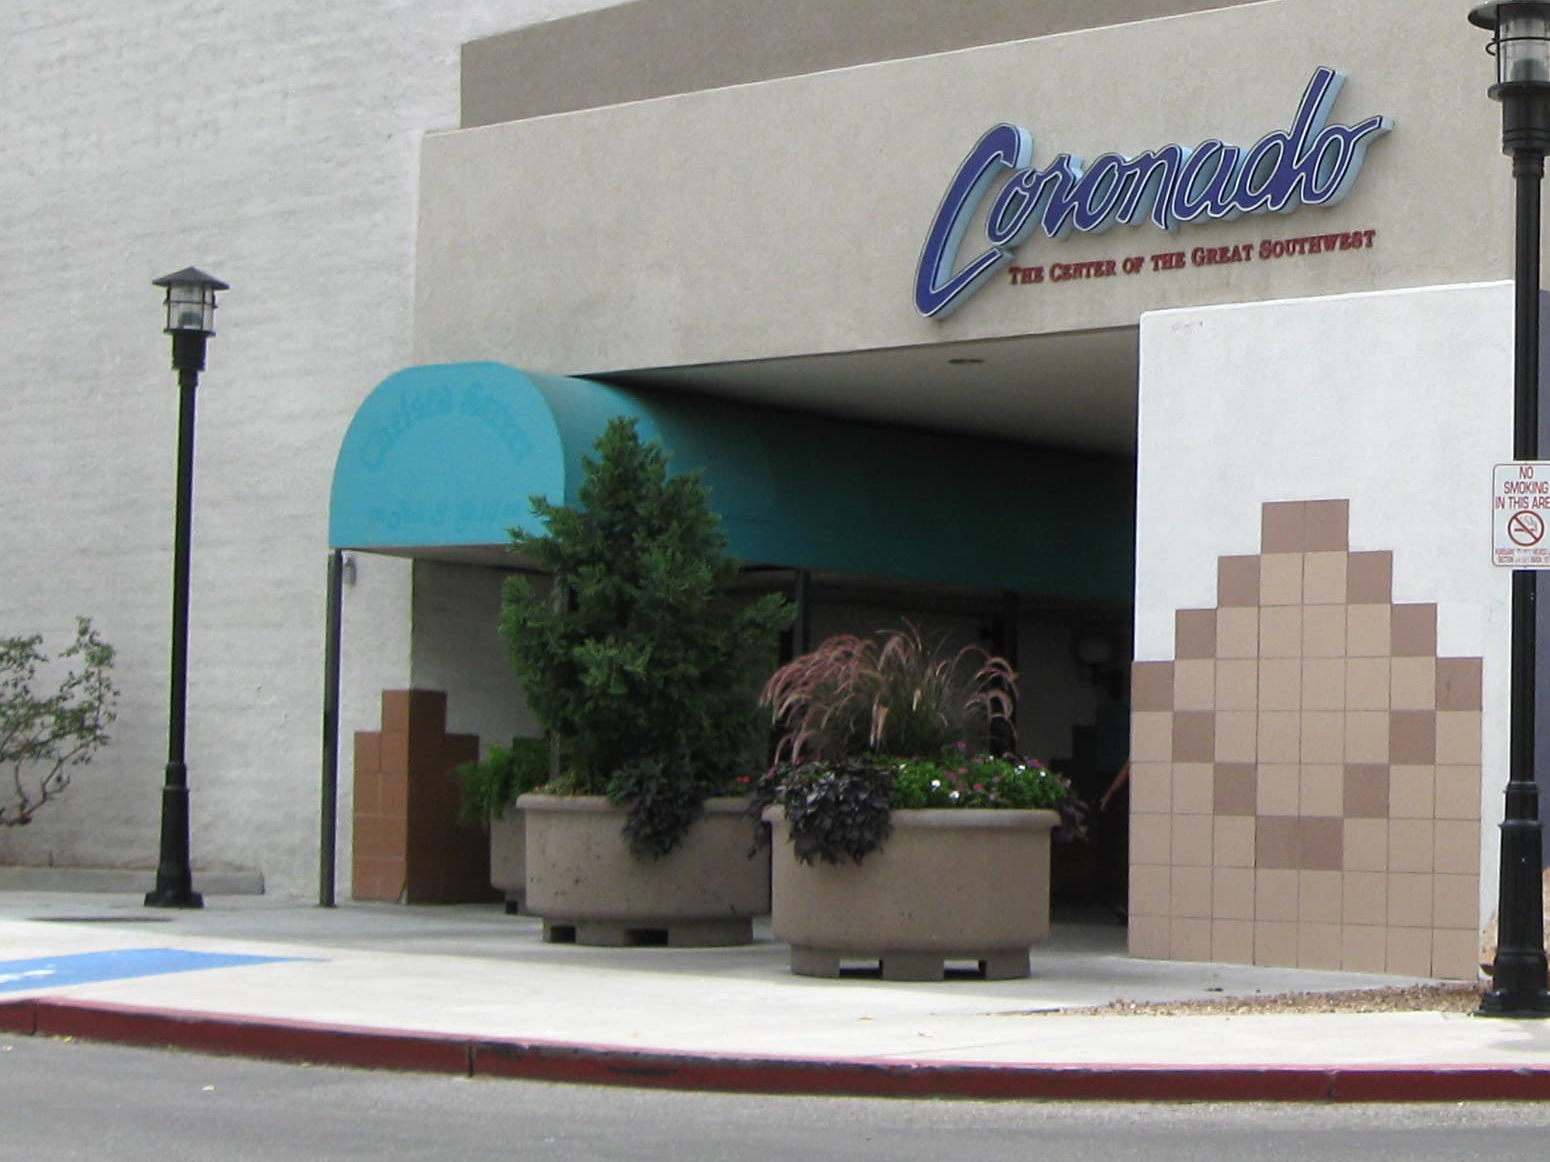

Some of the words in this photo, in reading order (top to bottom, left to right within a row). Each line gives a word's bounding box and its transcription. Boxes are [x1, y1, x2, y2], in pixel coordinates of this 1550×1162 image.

[912, 65, 1395, 319] Coronado
[1008, 265, 1044, 285] THE
[1050, 259, 1117, 283] CENTER
[1122, 255, 1145, 275] OF
[1151, 250, 1186, 272] THE
[1190, 243, 1254, 268] GREAT
[1258, 229, 1377, 261] SOUTHWEST
[1519, 466, 1534, 479] NO
[1503, 481, 1549, 495] SMOKING
[1495, 496, 1505, 510] IN
[1508, 496, 1530, 510] THIS
